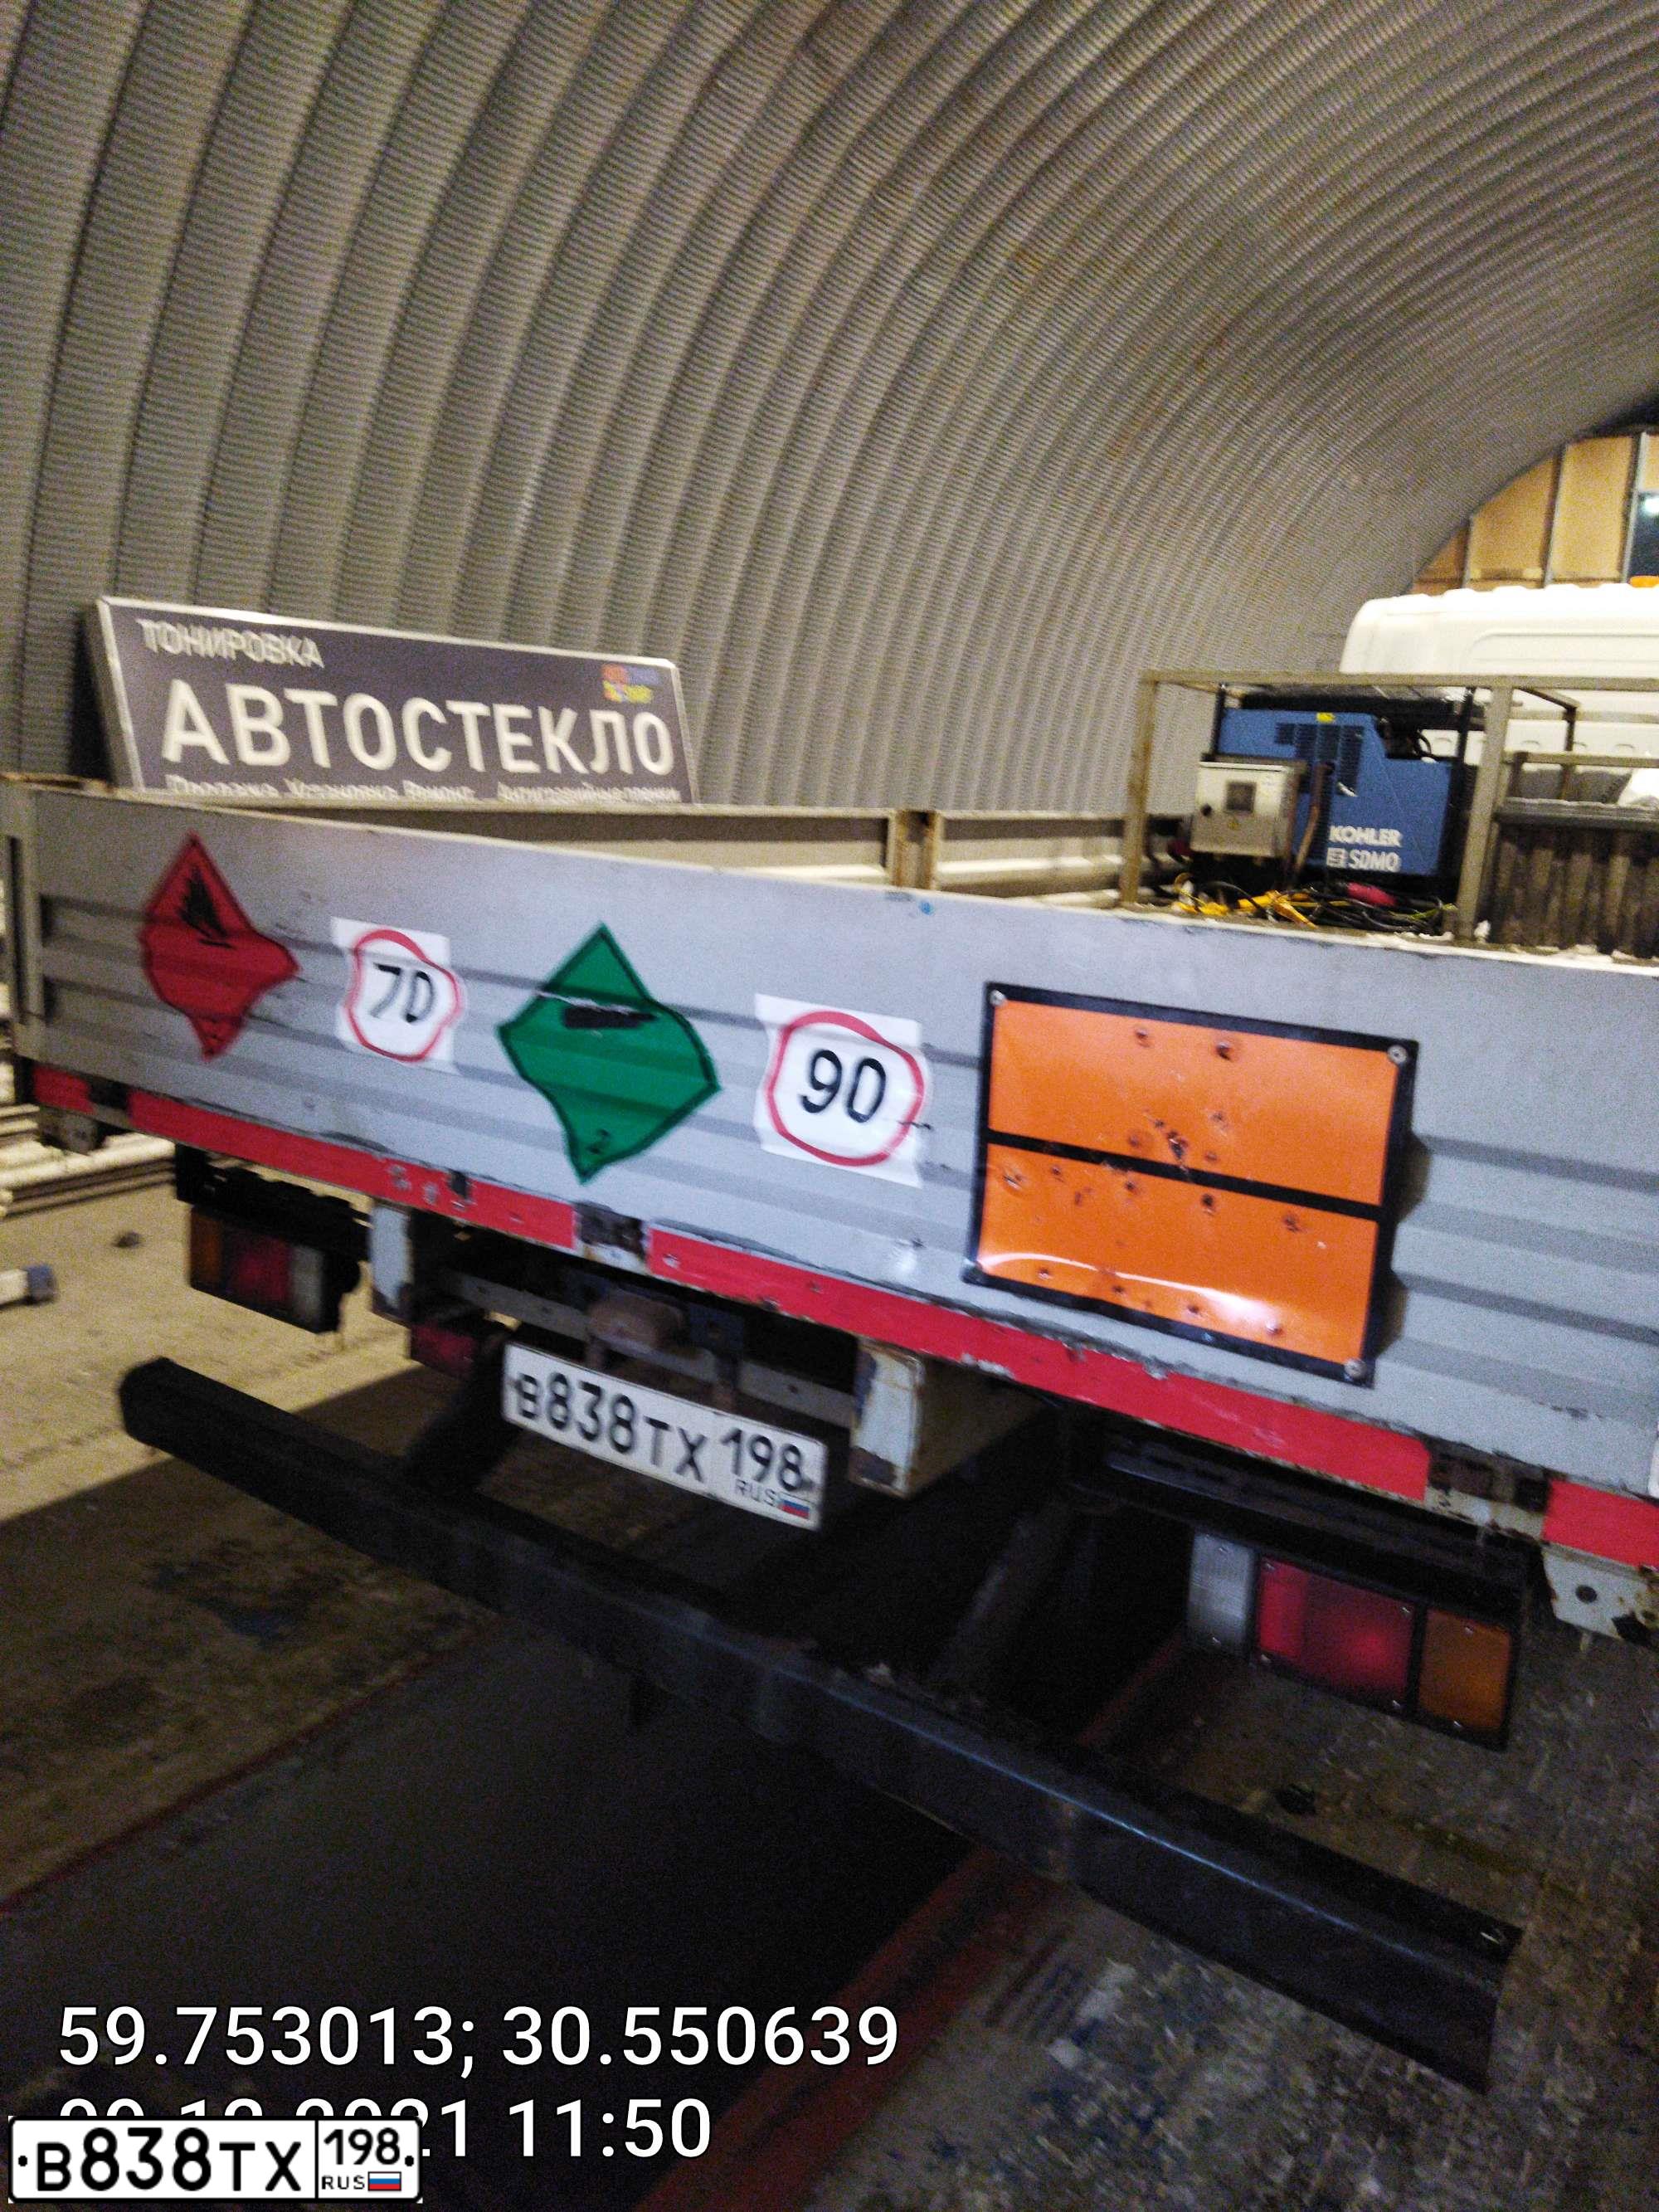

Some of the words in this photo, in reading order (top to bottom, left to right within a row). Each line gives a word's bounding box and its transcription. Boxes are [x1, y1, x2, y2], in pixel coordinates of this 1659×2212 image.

[137, 621, 324, 668] ТОНИРОВКА
[162, 679, 674, 775] АВТОСТЕКЛО
[1329, 825, 1403, 847] KOHLER
[1349, 849, 1402, 872] SDMO
[372, 962, 435, 1025] 70
[800, 1049, 887, 1125] 90
[721, 1428, 806, 1492] 198
[735, 1480, 778, 1507] RUS
